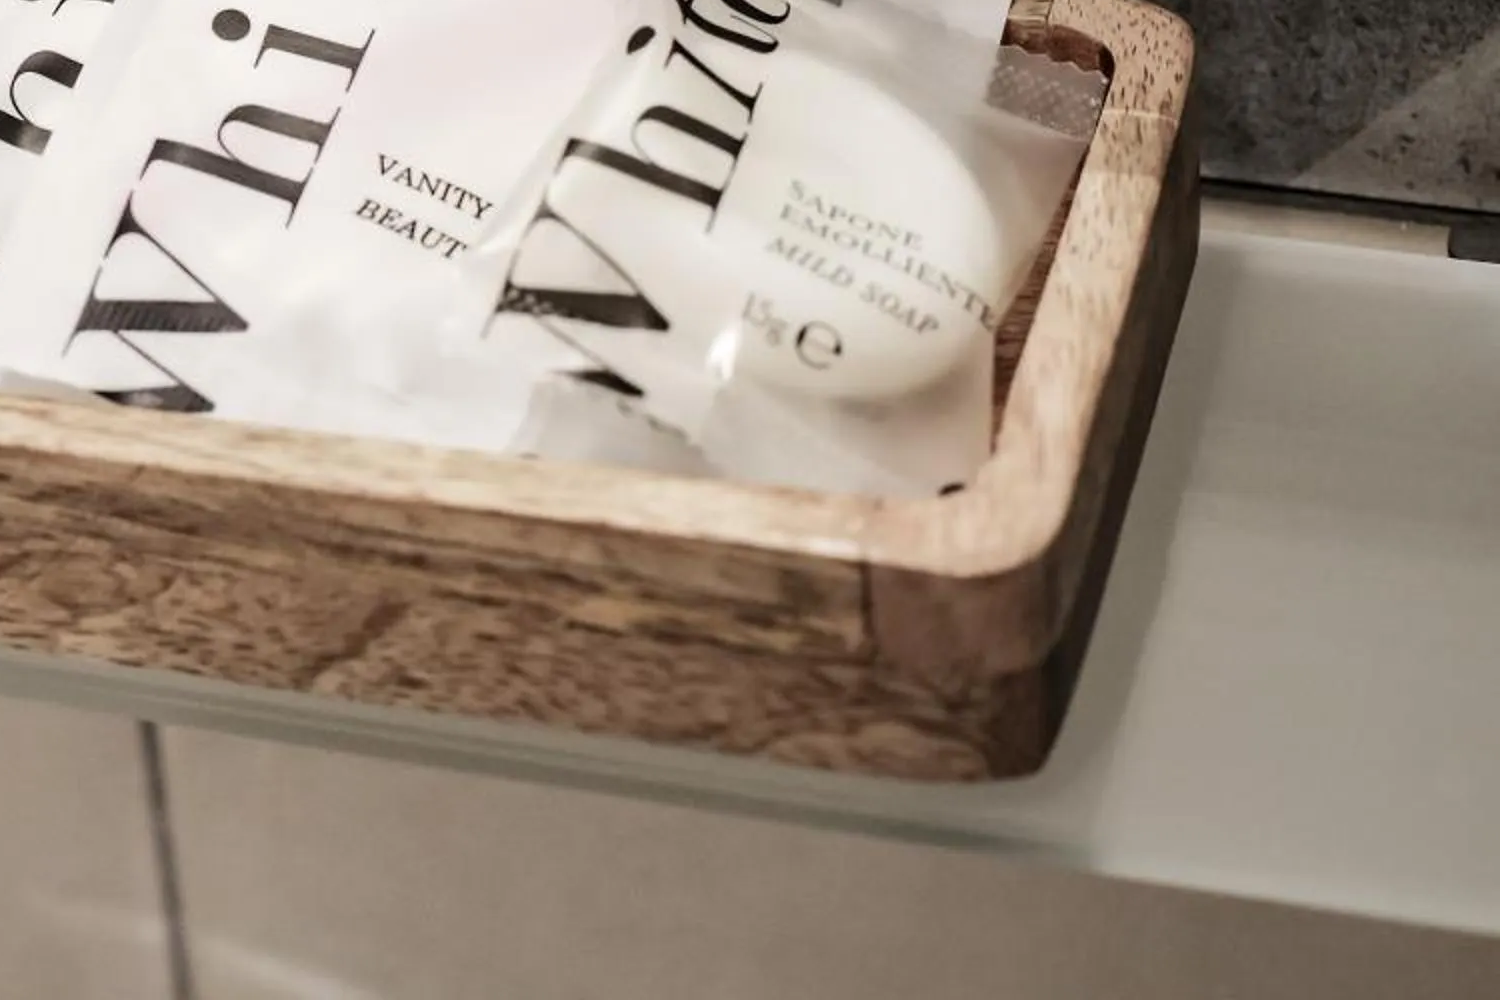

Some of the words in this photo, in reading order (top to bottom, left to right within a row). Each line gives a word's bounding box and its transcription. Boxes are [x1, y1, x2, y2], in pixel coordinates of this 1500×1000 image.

[377, 153, 493, 221] VANITY
[788, 178, 924, 251] SAPONE
[764, 234, 855, 290] MILD
[857, 280, 941, 337] SOAP
[778, 202, 998, 334] EMOLLIENTE
